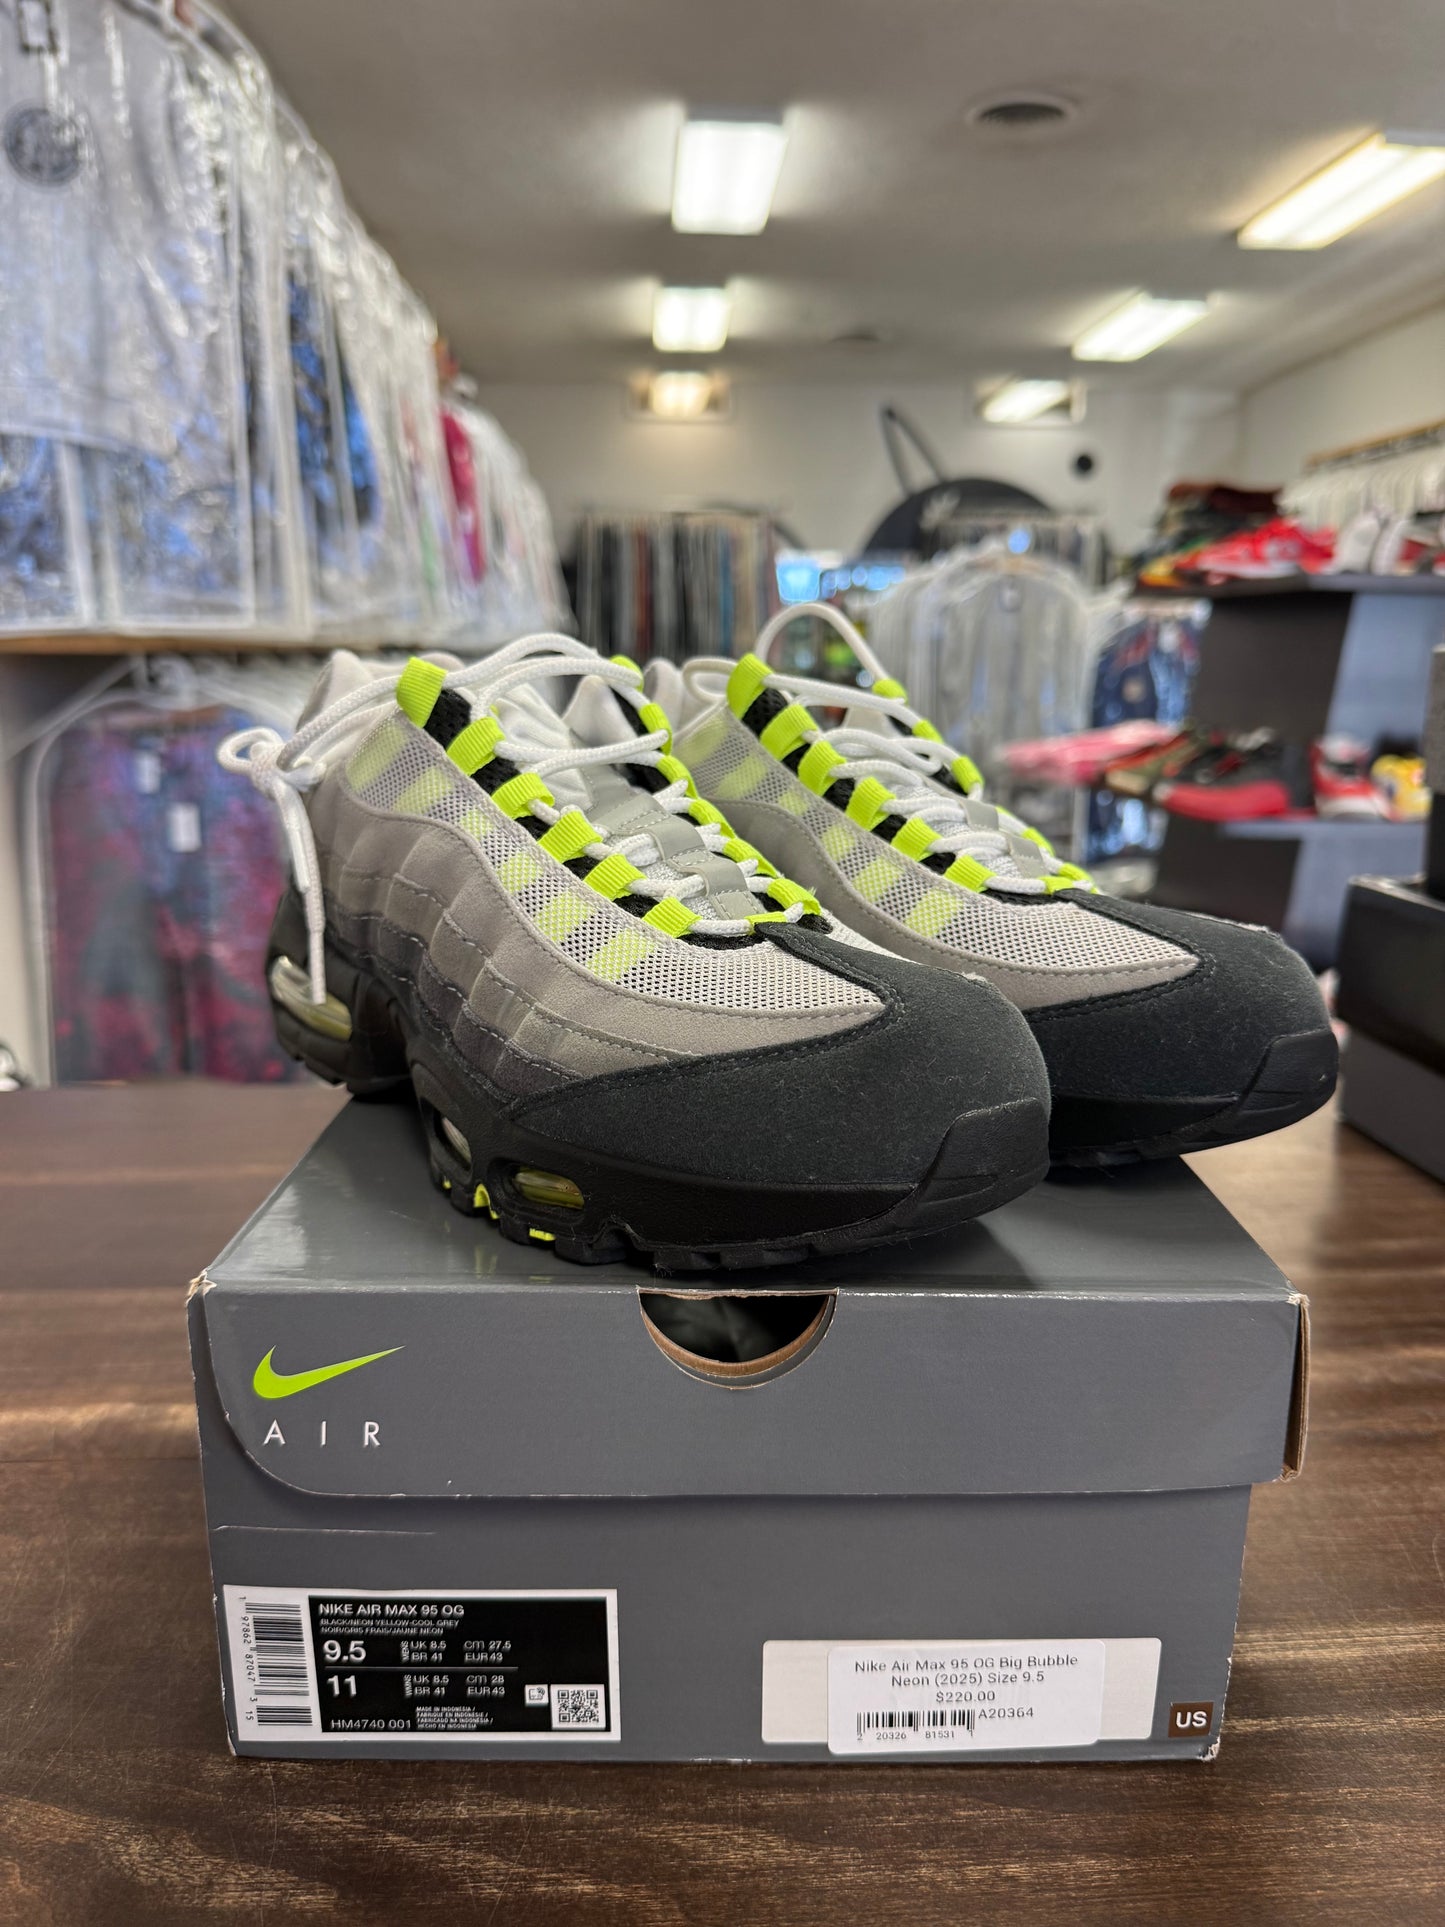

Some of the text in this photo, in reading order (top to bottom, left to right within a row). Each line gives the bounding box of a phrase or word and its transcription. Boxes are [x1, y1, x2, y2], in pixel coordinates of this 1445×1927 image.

[263, 1419, 381, 1446] AIR
[318, 1603, 465, 1616] NIKE AIR MAX 95 OG
[322, 1639, 367, 1662] 9.5
[410, 1640, 428, 1650] UK
[430, 1640, 447, 1650] 8.5
[488, 1640, 512, 1650] 27.5
[411, 1651, 503, 1662] BR 41 EUR 43
[855, 1653, 1078, 1673] Nike Air Max 95 OG Big Bubble
[413, 1674, 430, 1684] UK
[432, 1674, 449, 1684] 8.5
[491, 1674, 505, 1684] 28
[891, 1670, 1045, 1687] Neon (2025) Size 9.5
[326, 1674, 358, 1698] 11
[414, 1686, 505, 1696] BR 41 EUR 43
[935, 1690, 996, 1703] $220.00
[978, 1706, 1035, 1720] A20364
[1175, 1710, 1208, 1729] US
[330, 1719, 411, 1730] HM4740 001
[876, 1731, 907, 1741] 20326
[925, 1729, 956, 1739] 81531
